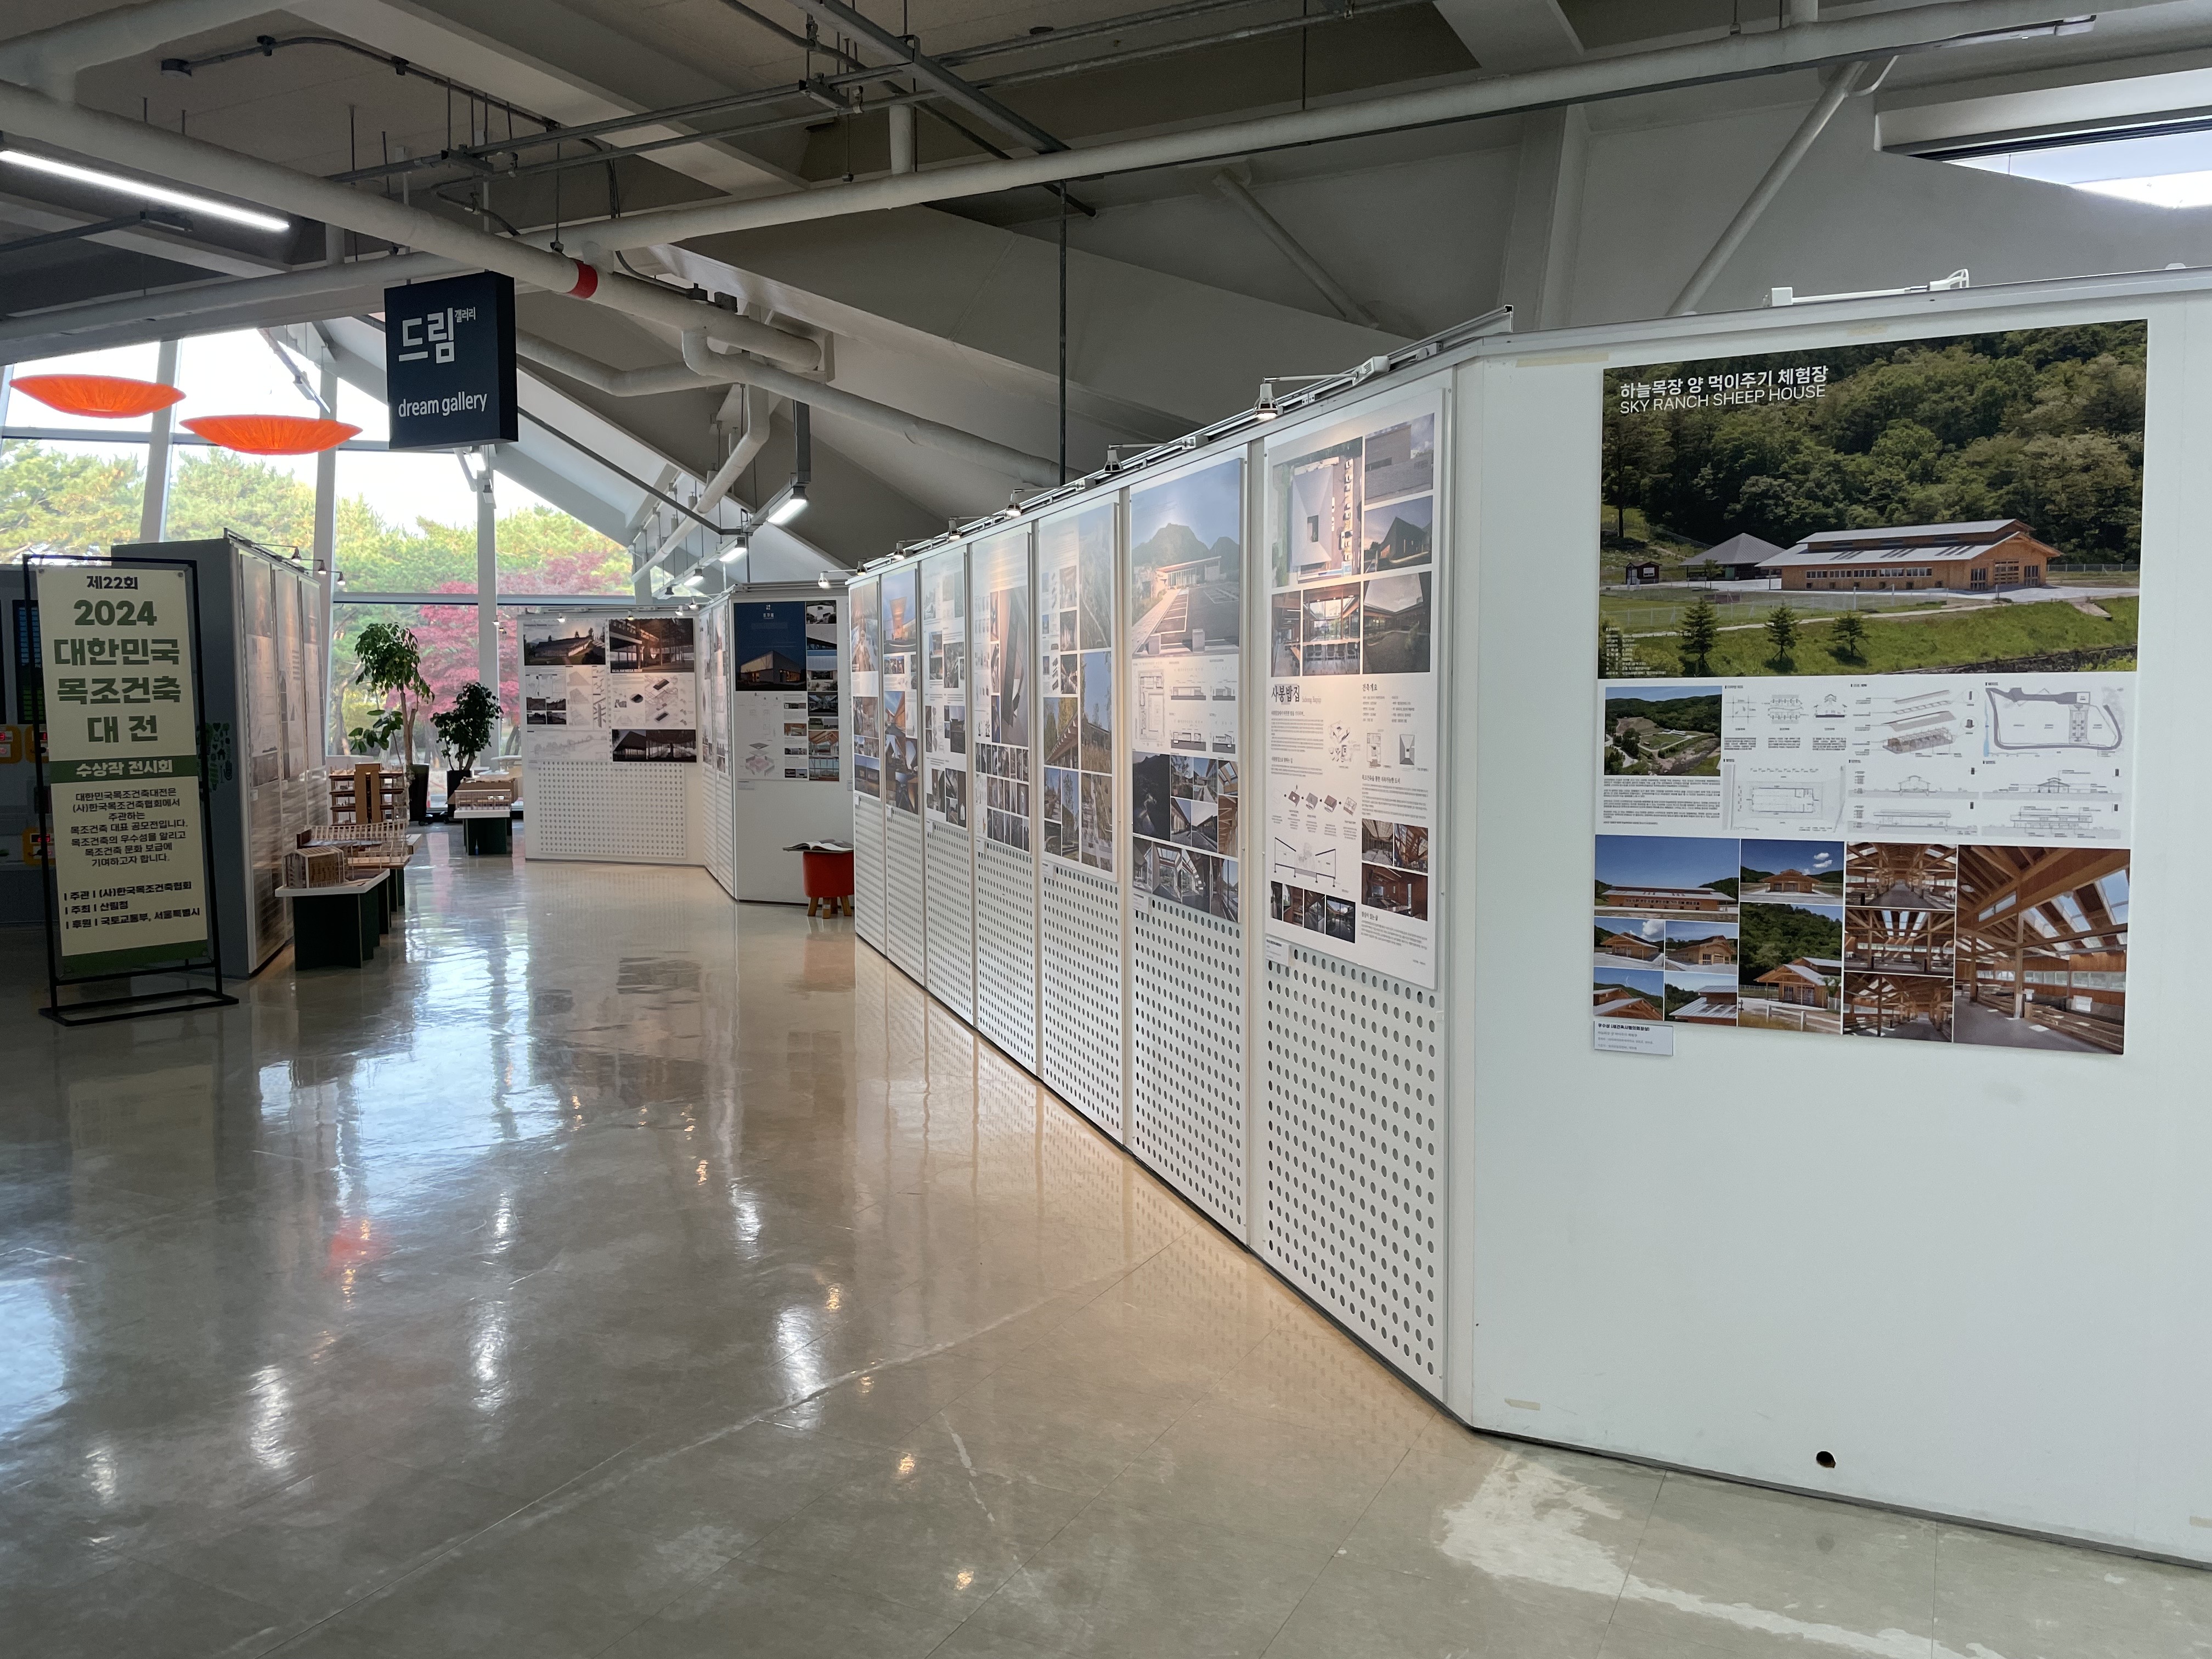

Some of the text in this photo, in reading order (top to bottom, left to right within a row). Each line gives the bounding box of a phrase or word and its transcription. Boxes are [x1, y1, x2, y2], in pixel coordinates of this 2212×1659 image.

[398, 306, 476, 364] 드림 갤러리
[1620, 365, 1829, 399] 하늘목장 양 먹이주기 체험장
[398, 391, 488, 417] dream gallery
[1620, 384, 1826, 415] SKY RANCH SHEEP HOUSE
[86, 575, 138, 590] 제22회
[74, 599, 157, 626] 2024
[54, 637, 180, 666] 대한민국
[57, 675, 182, 705] 목조건축
[1271, 685, 1300, 703] 사봉밥집
[87, 715, 158, 743] 대 전
[76, 759, 173, 777] 수상작 전시회
[75, 788, 177, 802] 대한민국목조건축대전은
[72, 798, 180, 813] (사)한국목조건축협회에서
[108, 811, 145, 822] 주관하는
[70, 819, 188, 835] 목조건축 대표 공모전입니다.
[71, 831, 186, 847] 목조건축의 우수성을 알리고
[84, 842, 173, 856] 목조건축 문화 보급에
[91, 853, 171, 867] 기여하고자 합니다.
[70, 881, 192, 900] 주관 (사)한국목조건축협회
[71, 900, 129, 914] 주최 산림청
[72, 907, 201, 929] 후원 국토교통부, 서울특별시
